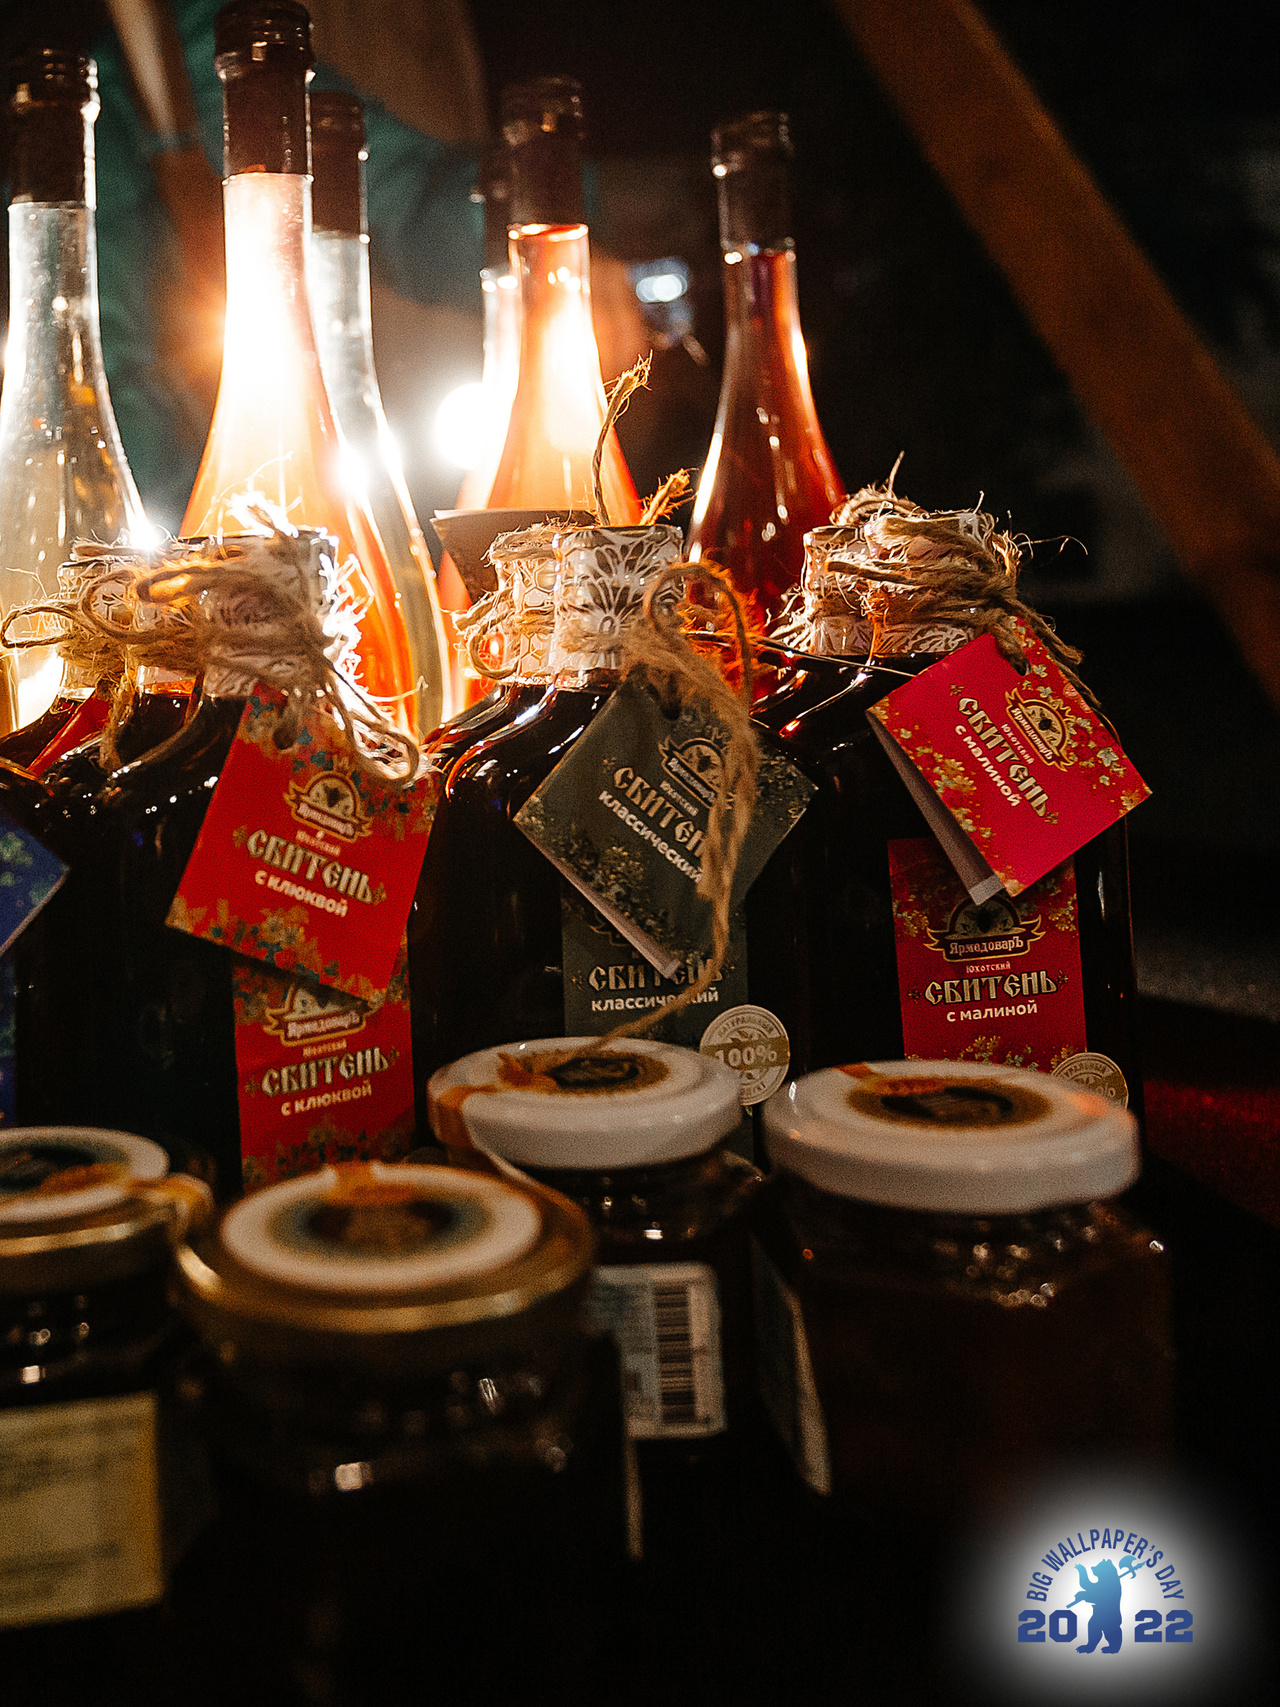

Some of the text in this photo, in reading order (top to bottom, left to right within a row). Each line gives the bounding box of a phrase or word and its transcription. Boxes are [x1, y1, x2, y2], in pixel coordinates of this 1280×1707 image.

[955, 725, 1022, 807] с малиной
[958, 697, 1049, 817] СБИТЕНЬ
[1001, 723, 1035, 765] Юхотский
[613, 767, 705, 858] СБИТЕН
[246, 829, 373, 904] СБИТЕНЬ
[255, 869, 349, 917] с клюквой
[923, 969, 1058, 1006] СБИТЕНЬ
[965, 960, 1012, 974] Юхотский
[946, 999, 1039, 1022] с малиной
[261, 1045, 390, 1098] СБИТЕНЬ
[281, 1079, 373, 1117] с клюквой
